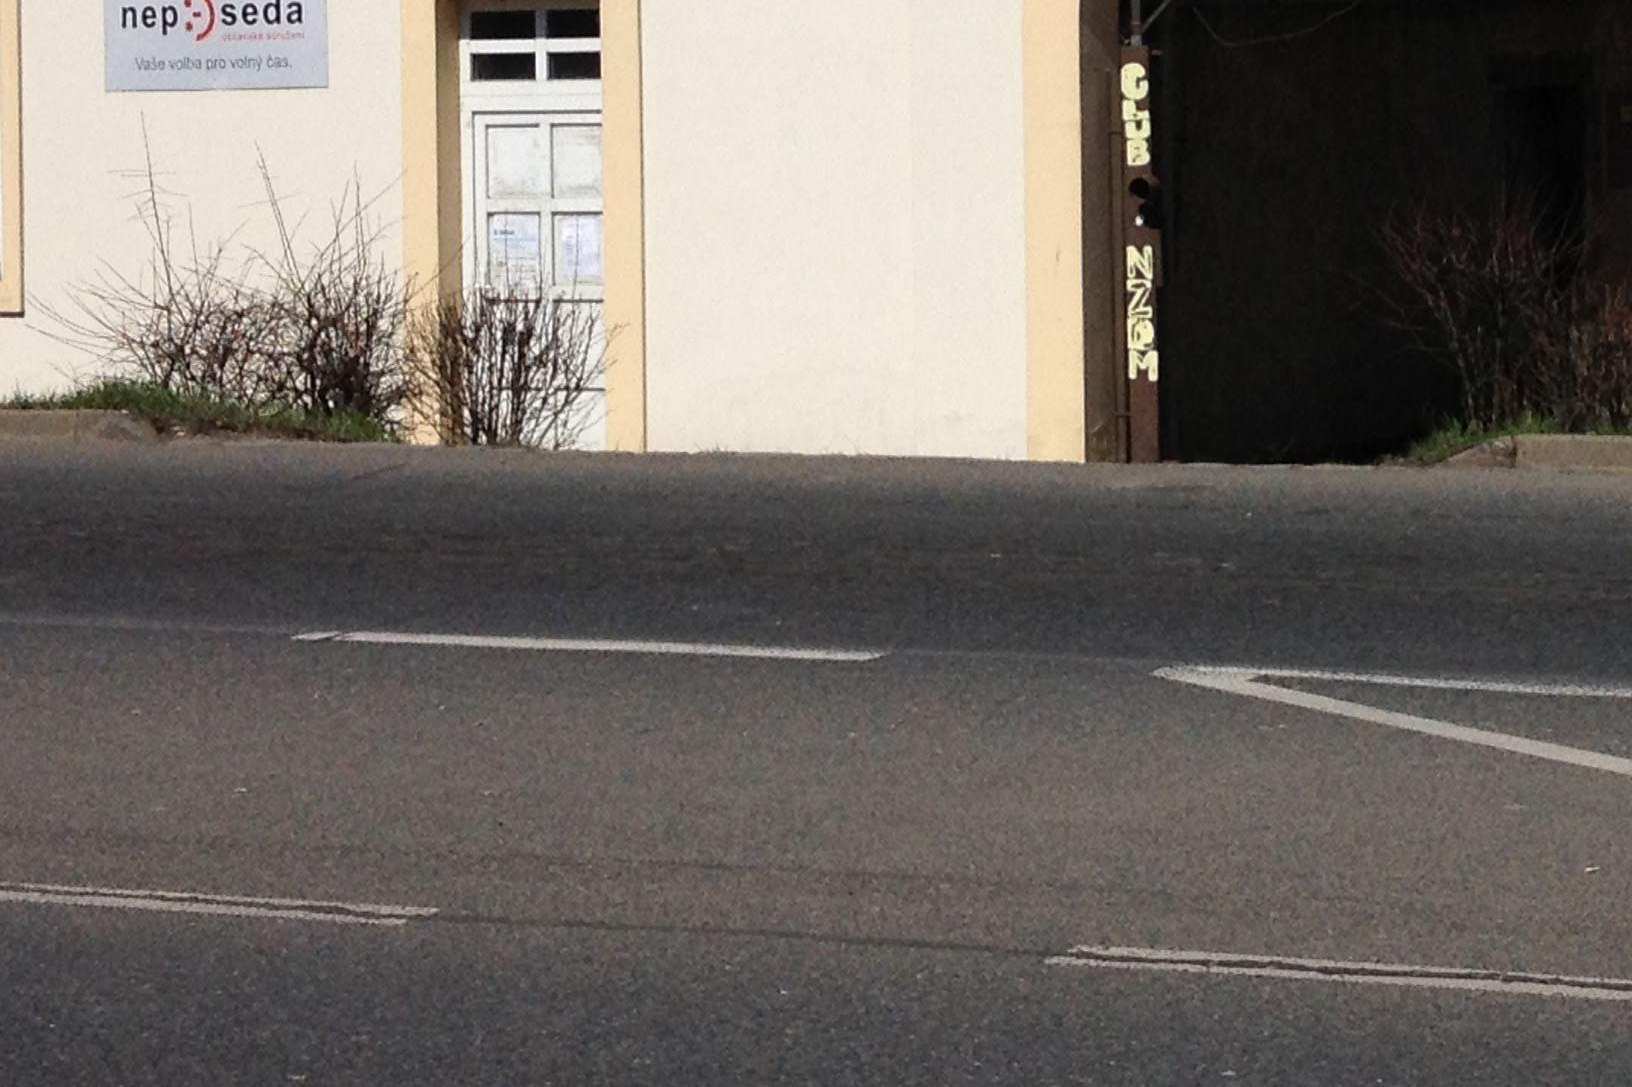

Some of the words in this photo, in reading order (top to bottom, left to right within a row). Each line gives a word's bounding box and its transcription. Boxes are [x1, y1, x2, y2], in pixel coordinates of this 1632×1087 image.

[135, 57, 165, 71] Vaše
[168, 56, 202, 71] volba
[206, 58, 226, 71] pro
[230, 55, 263, 72] volný
